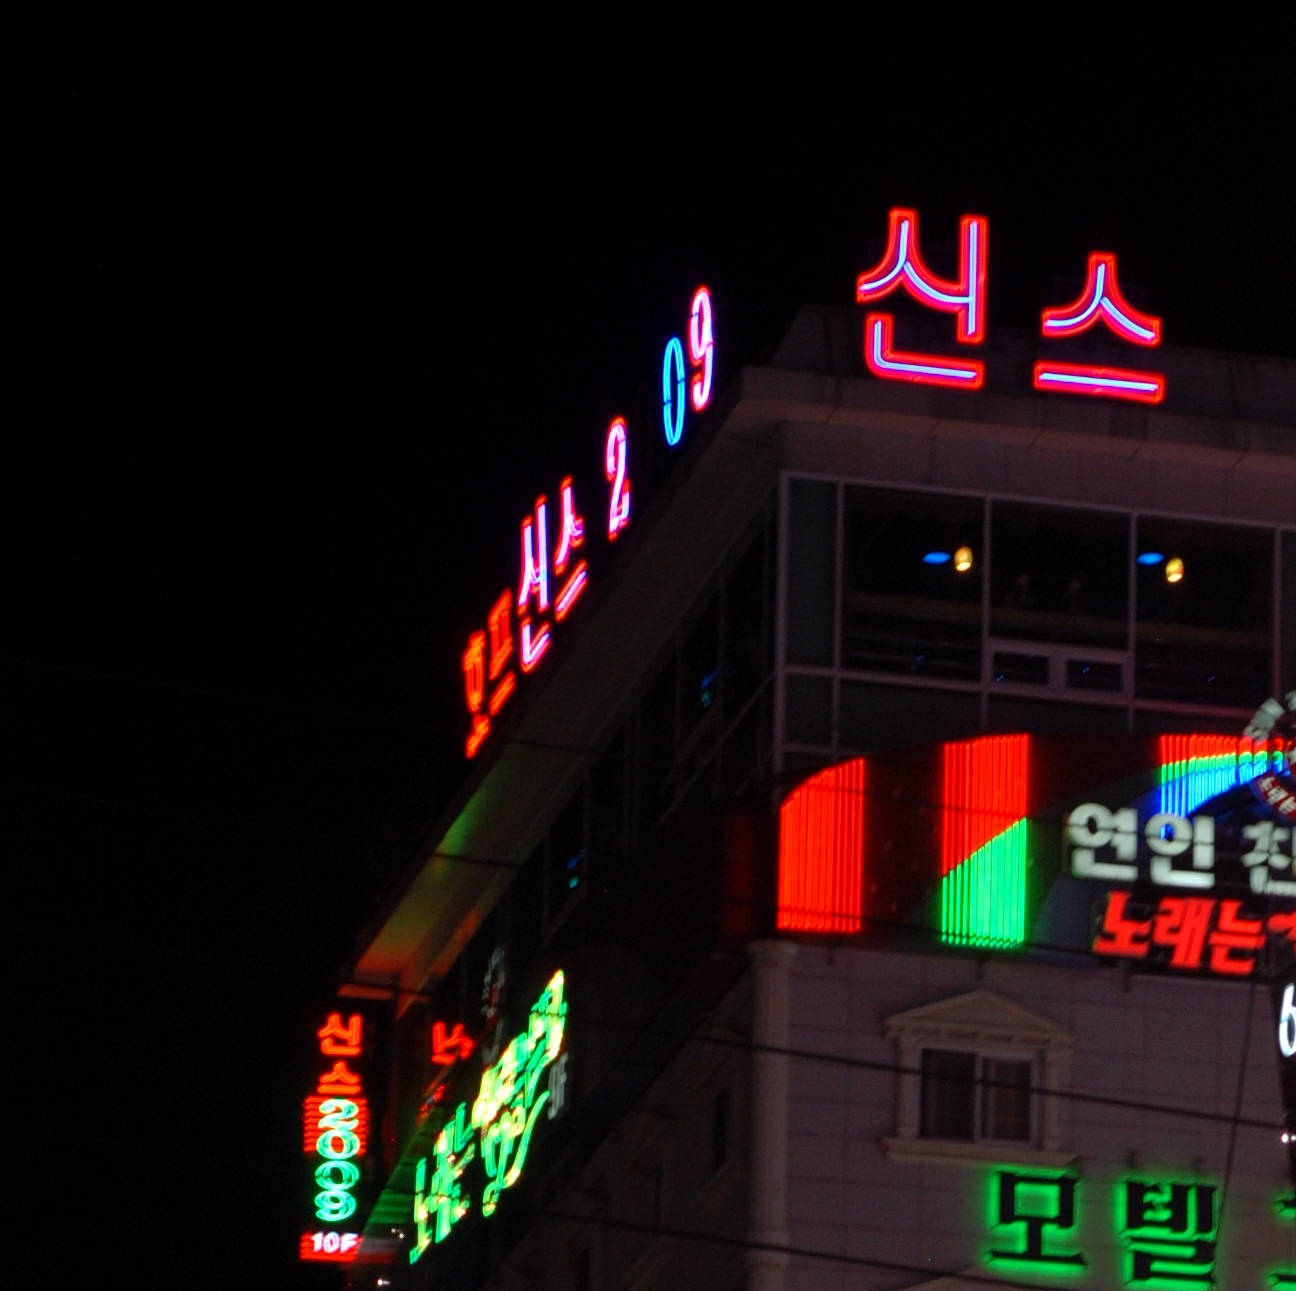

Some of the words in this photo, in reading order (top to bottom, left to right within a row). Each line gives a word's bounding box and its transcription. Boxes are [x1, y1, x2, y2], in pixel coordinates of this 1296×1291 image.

[856, 207, 1164, 403] 신스
[1068, 802, 1216, 889] 연인
[317, 1011, 364, 1095] 신스
[313, 1097, 361, 1223] 2009
[310, 1230, 359, 1255] 10F
